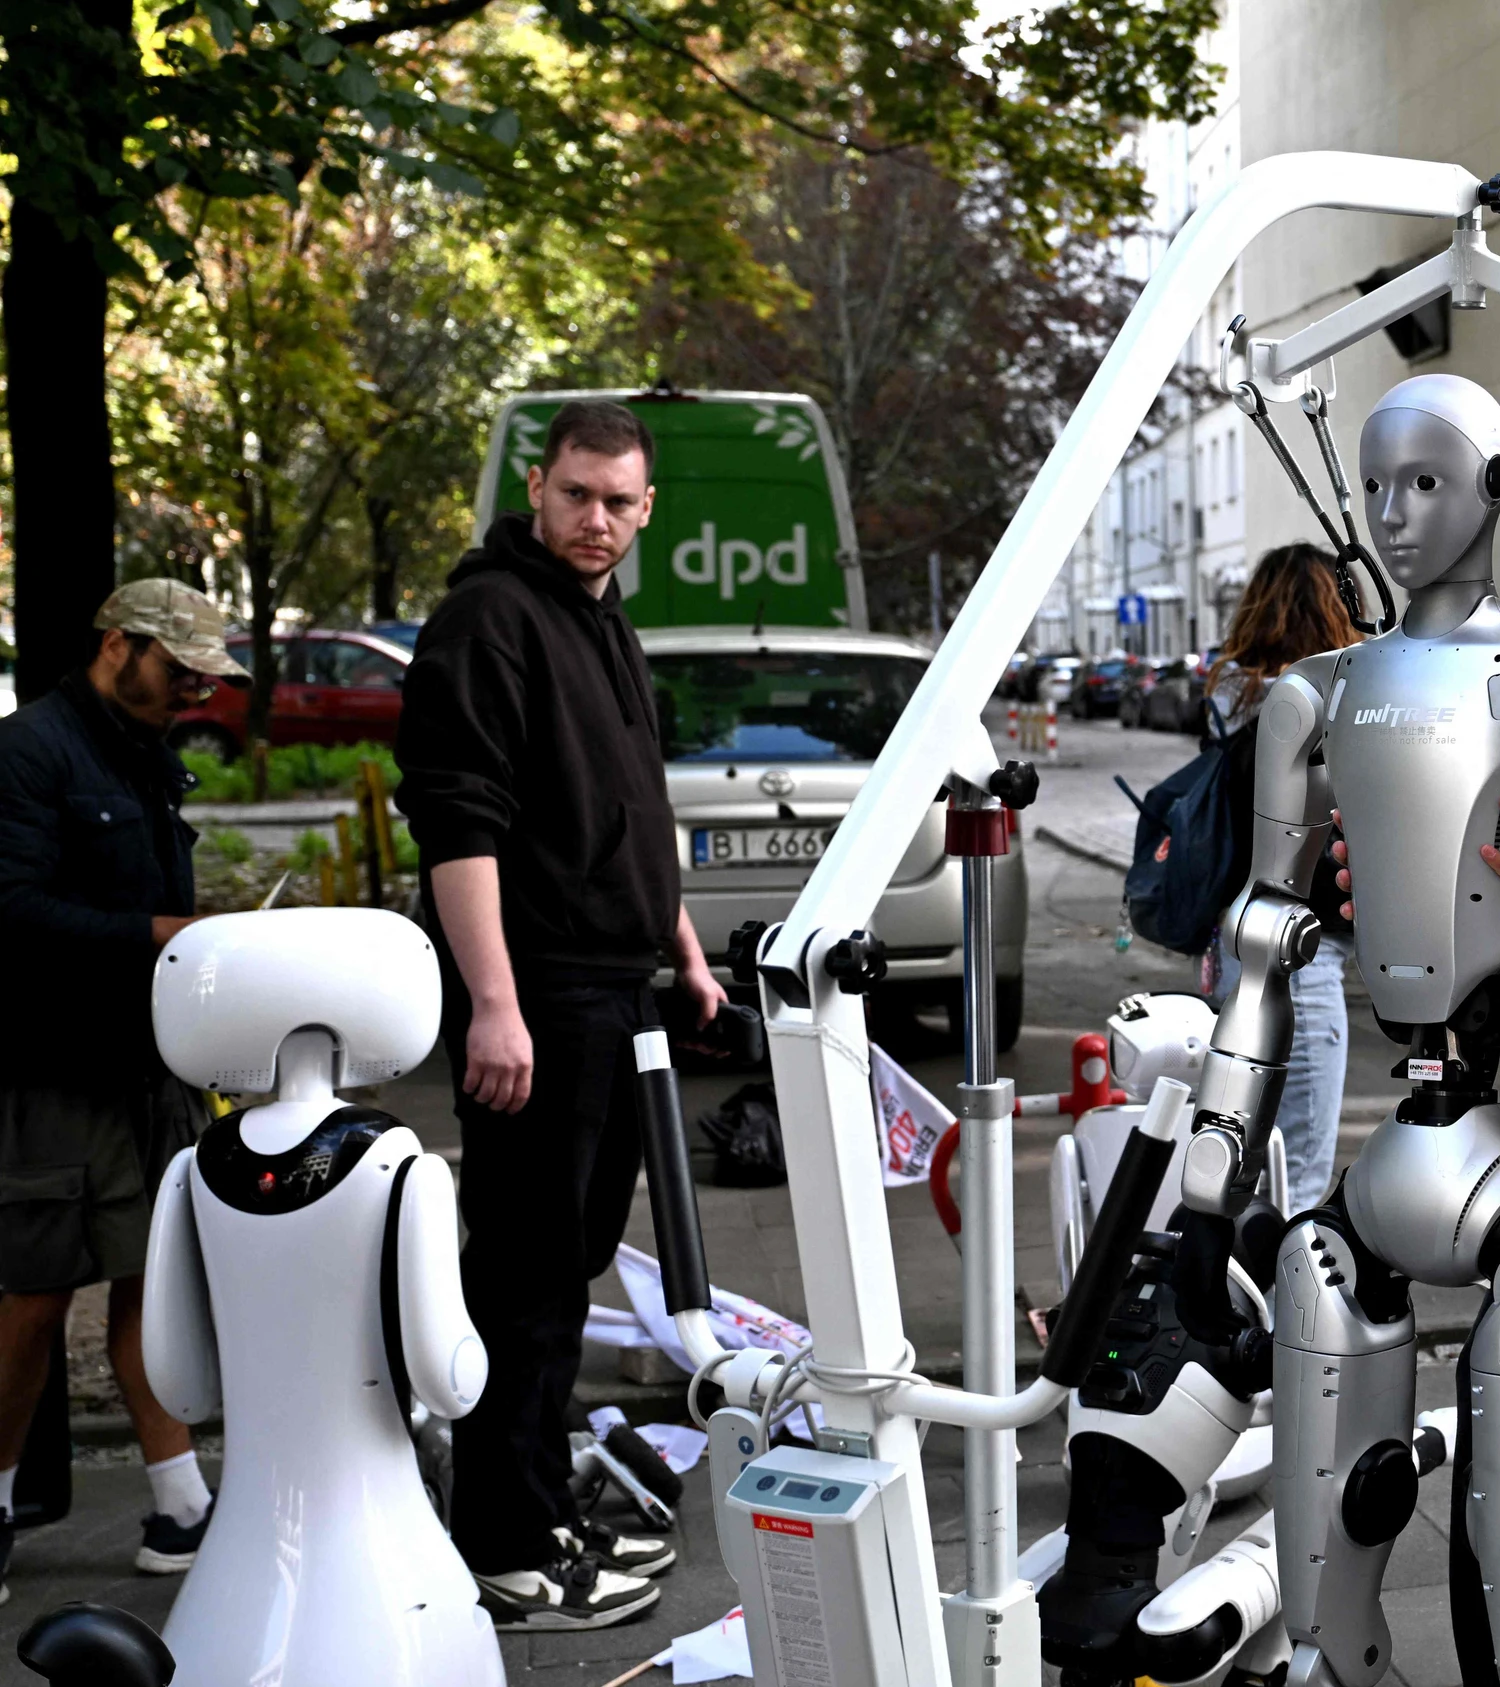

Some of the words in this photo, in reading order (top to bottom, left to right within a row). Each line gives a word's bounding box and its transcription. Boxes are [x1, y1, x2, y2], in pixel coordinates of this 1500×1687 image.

[672, 521, 807, 600] dpd
[1354, 704, 1456, 727] UNITREE
[1399, 737, 1415, 745] not
[1435, 736, 1457, 745] sale
[713, 831, 748, 858] BI
